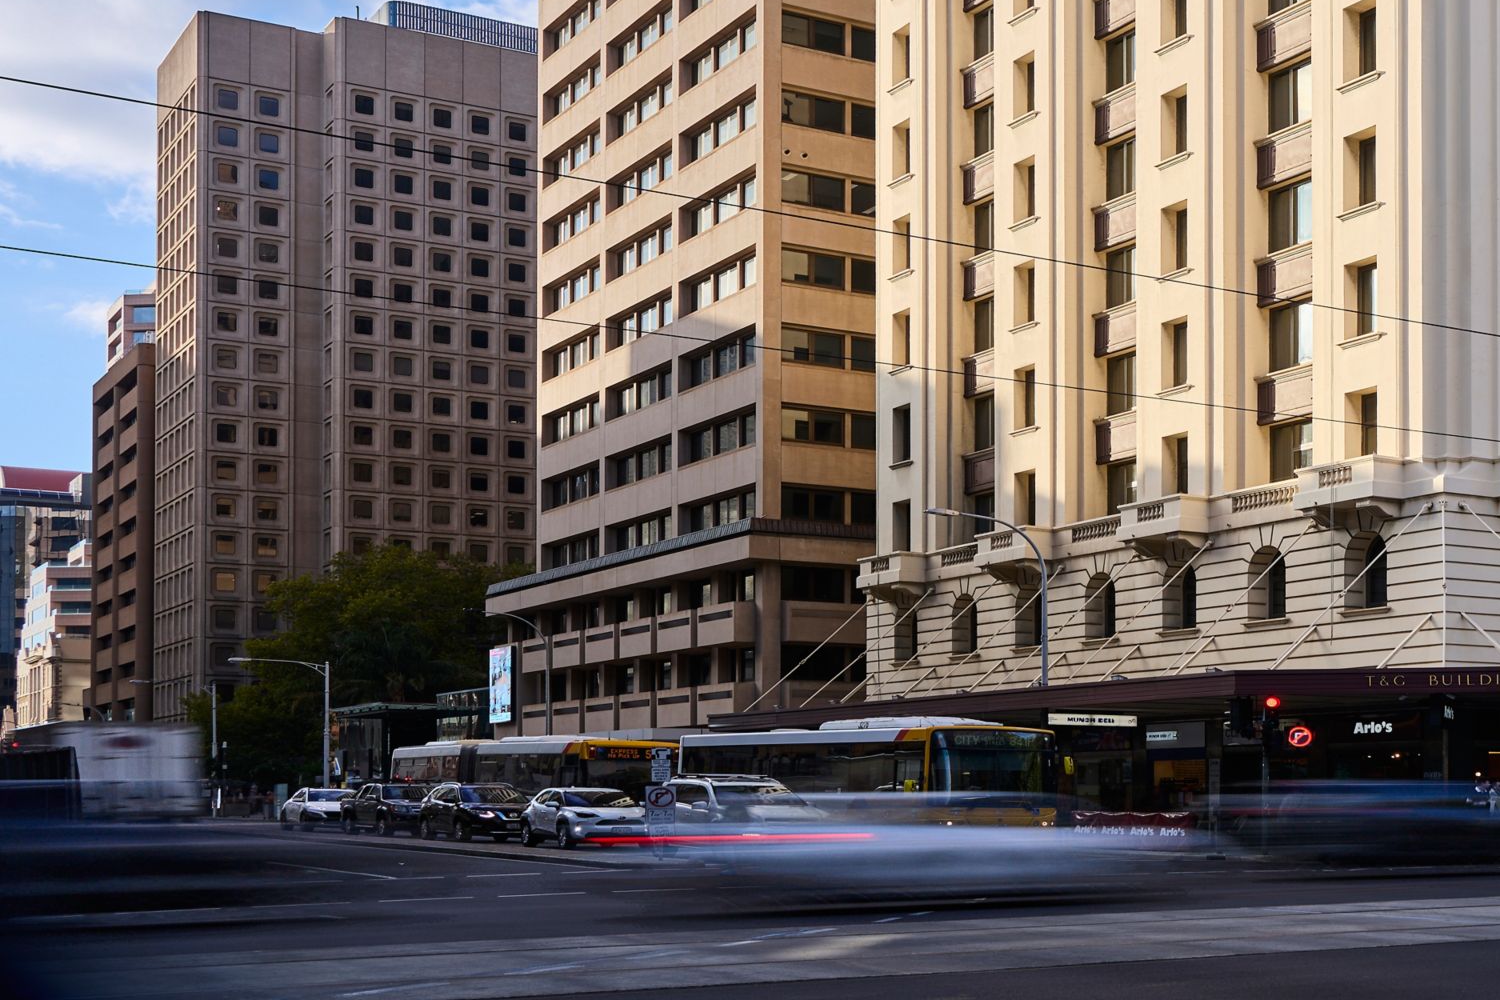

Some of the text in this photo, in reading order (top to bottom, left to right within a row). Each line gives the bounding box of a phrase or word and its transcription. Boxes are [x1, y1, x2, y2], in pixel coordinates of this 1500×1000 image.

[1365, 675, 1406, 687] T&G
[1353, 720, 1393, 734] Arlo's
[1101, 825, 1125, 835] Arlo's
[1129, 826, 1154, 836] Arlo's
[1159, 827, 1185, 837] Arlo's
